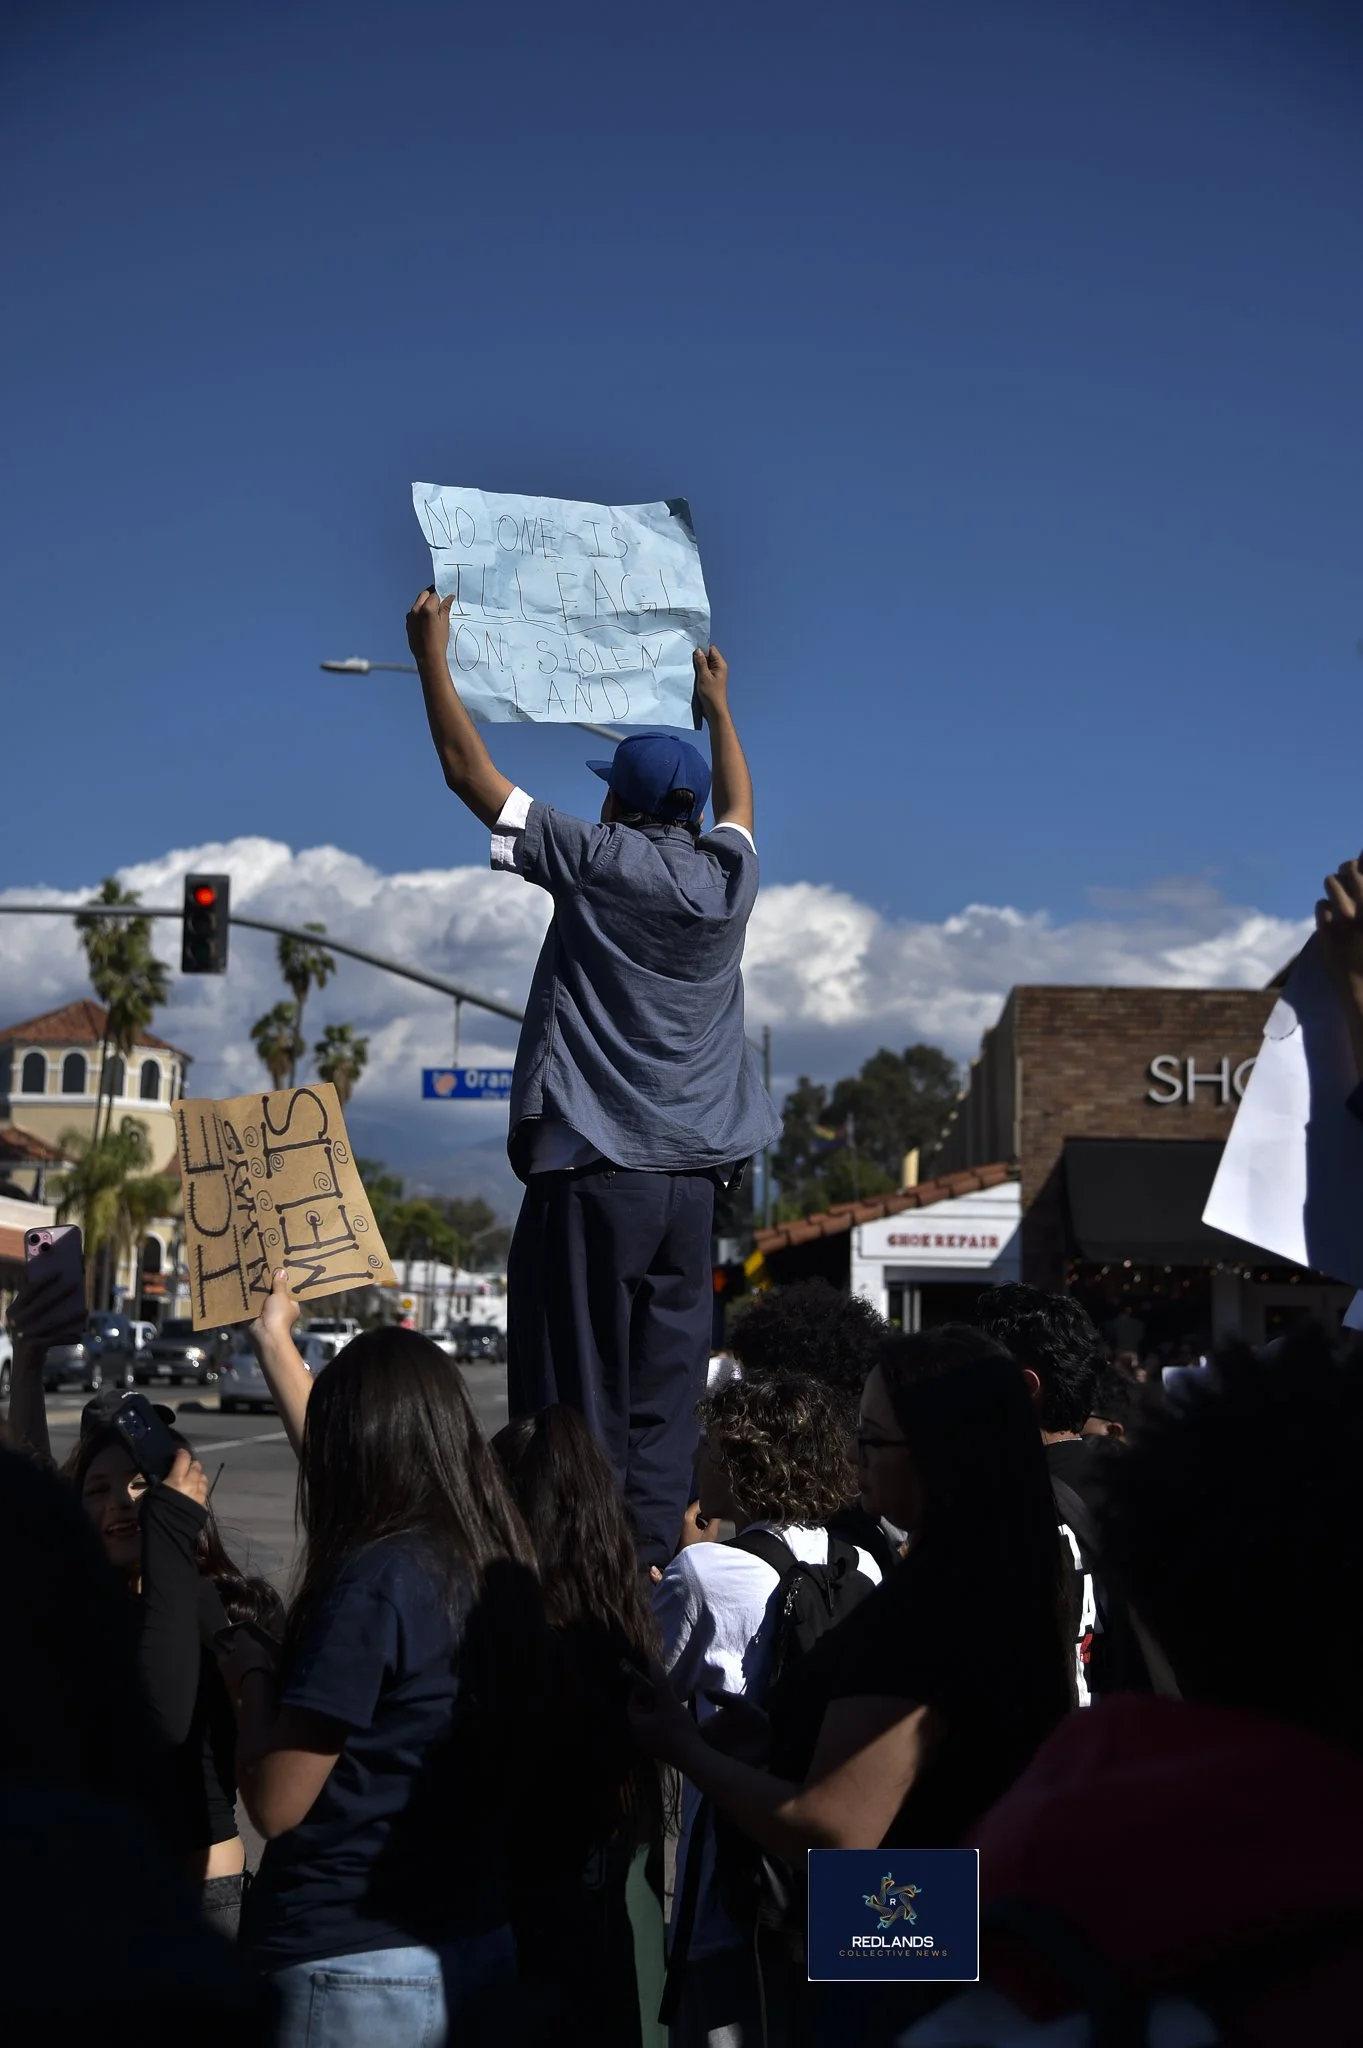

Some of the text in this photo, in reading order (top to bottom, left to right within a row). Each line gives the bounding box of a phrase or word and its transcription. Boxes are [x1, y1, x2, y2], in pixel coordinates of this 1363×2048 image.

[424, 497, 629, 559] NO ONE IS
[454, 624, 504, 672] ON
[511, 675, 630, 719] LAND
[179, 1109, 249, 1319] ICE
[219, 1116, 272, 1295] ALWAYS
[260, 1088, 375, 1294] MELTS
[934, 1233, 999, 1248] REPAIR
